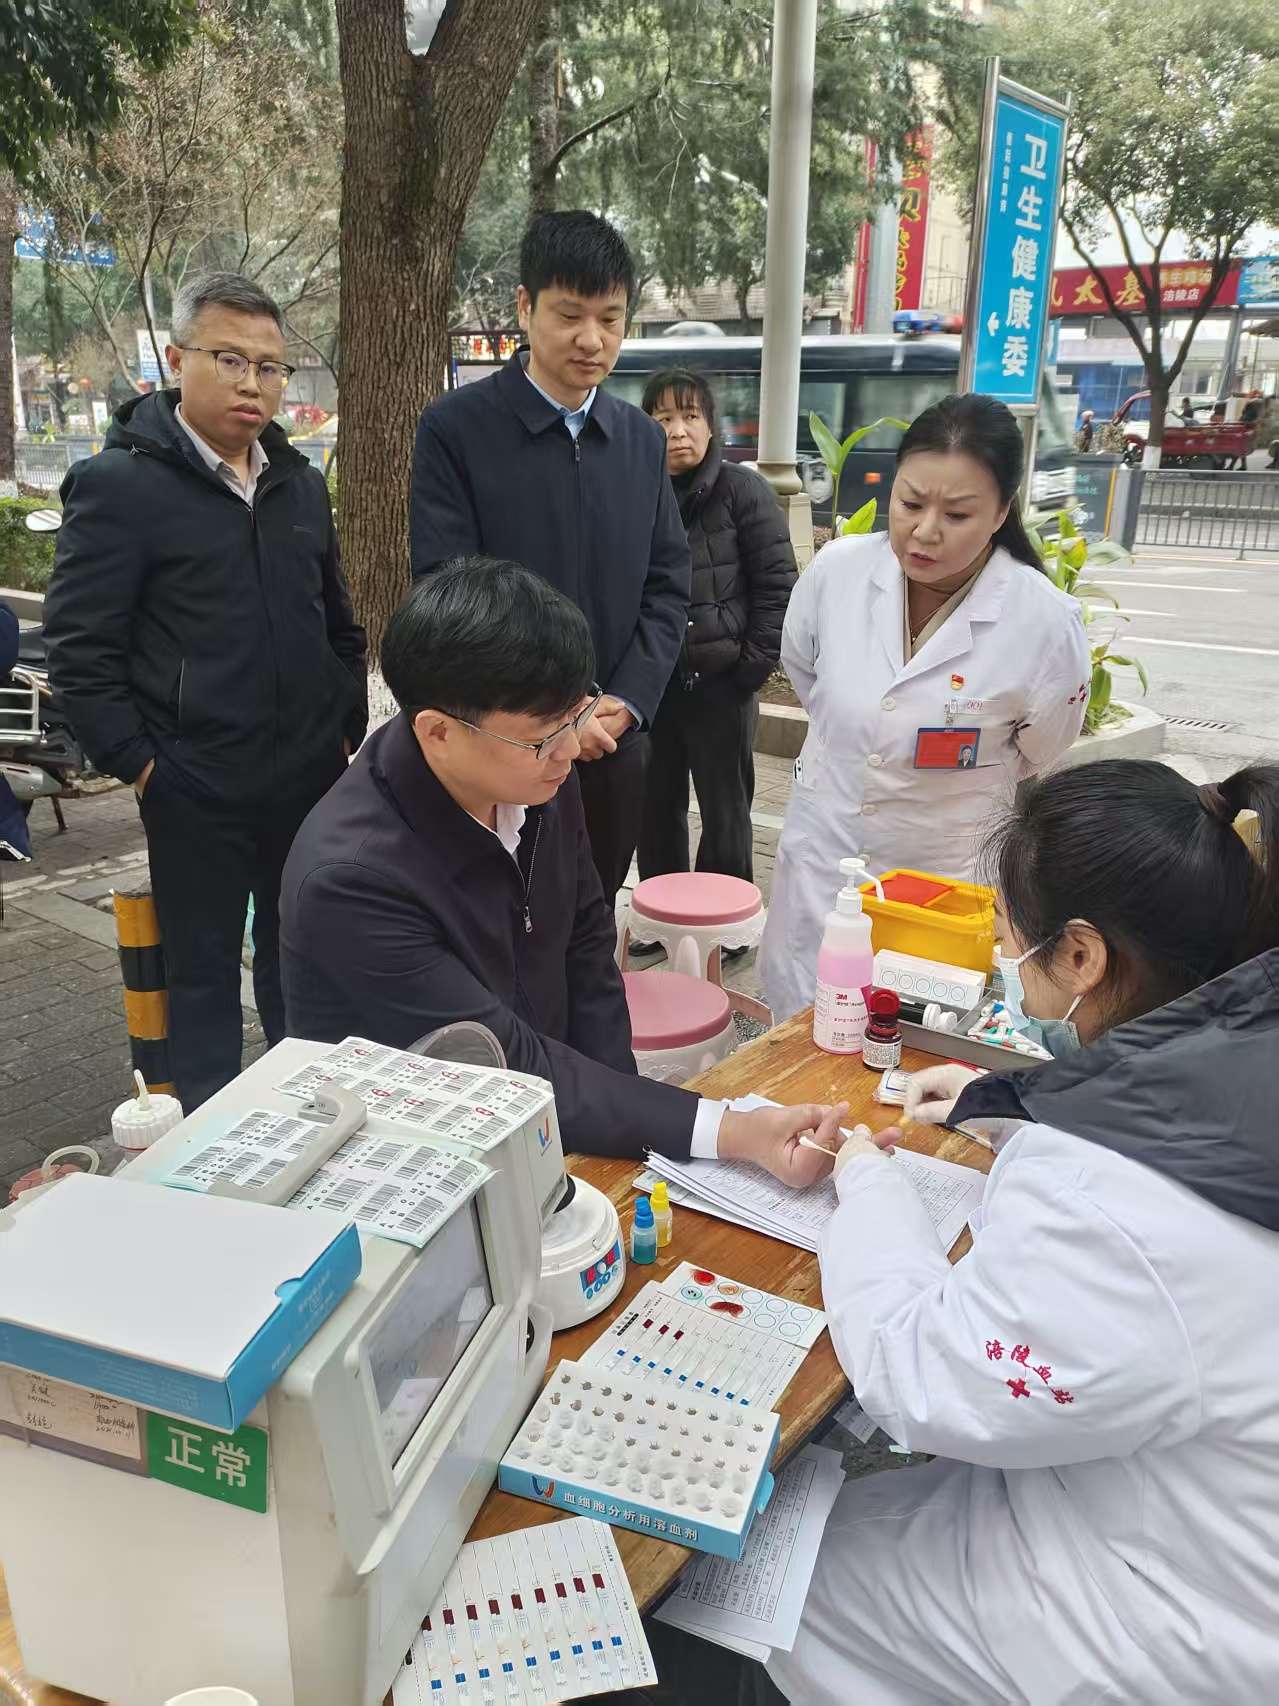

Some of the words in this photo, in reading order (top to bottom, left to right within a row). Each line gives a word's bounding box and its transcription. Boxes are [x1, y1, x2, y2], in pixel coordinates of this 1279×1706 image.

[1002, 133, 1048, 377] 卫生健康委
[164, 1426, 252, 1488] 正常
[563, 1492, 699, 1541] 血细胞分析用溶血剂
